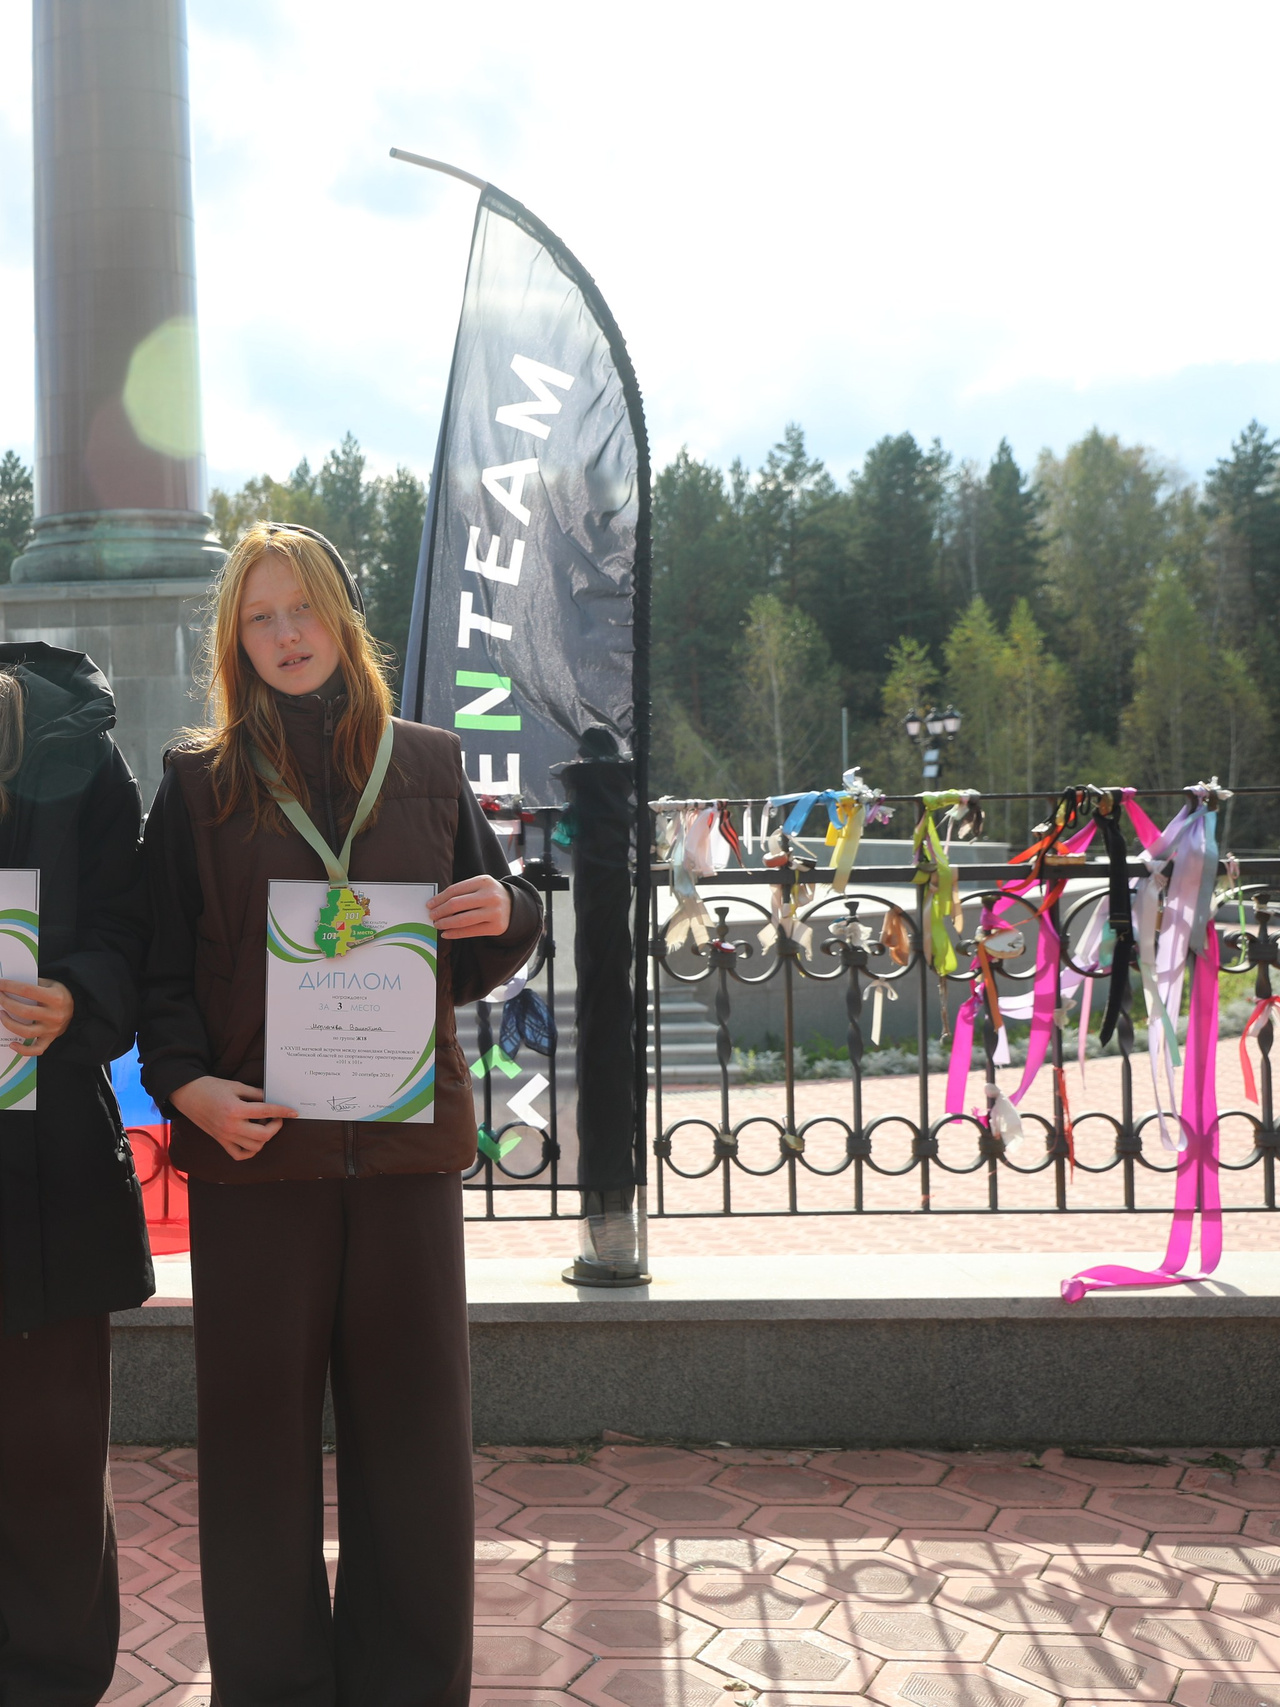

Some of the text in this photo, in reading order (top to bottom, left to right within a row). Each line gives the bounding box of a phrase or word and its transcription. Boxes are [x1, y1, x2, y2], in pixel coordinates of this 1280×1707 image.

[345, 912, 360, 920] 101
[322, 932, 338, 940] 101
[298, 971, 402, 990] ДИПЛОМ
[318, 1002, 380, 1012] ЗА 3 МЕСТО
